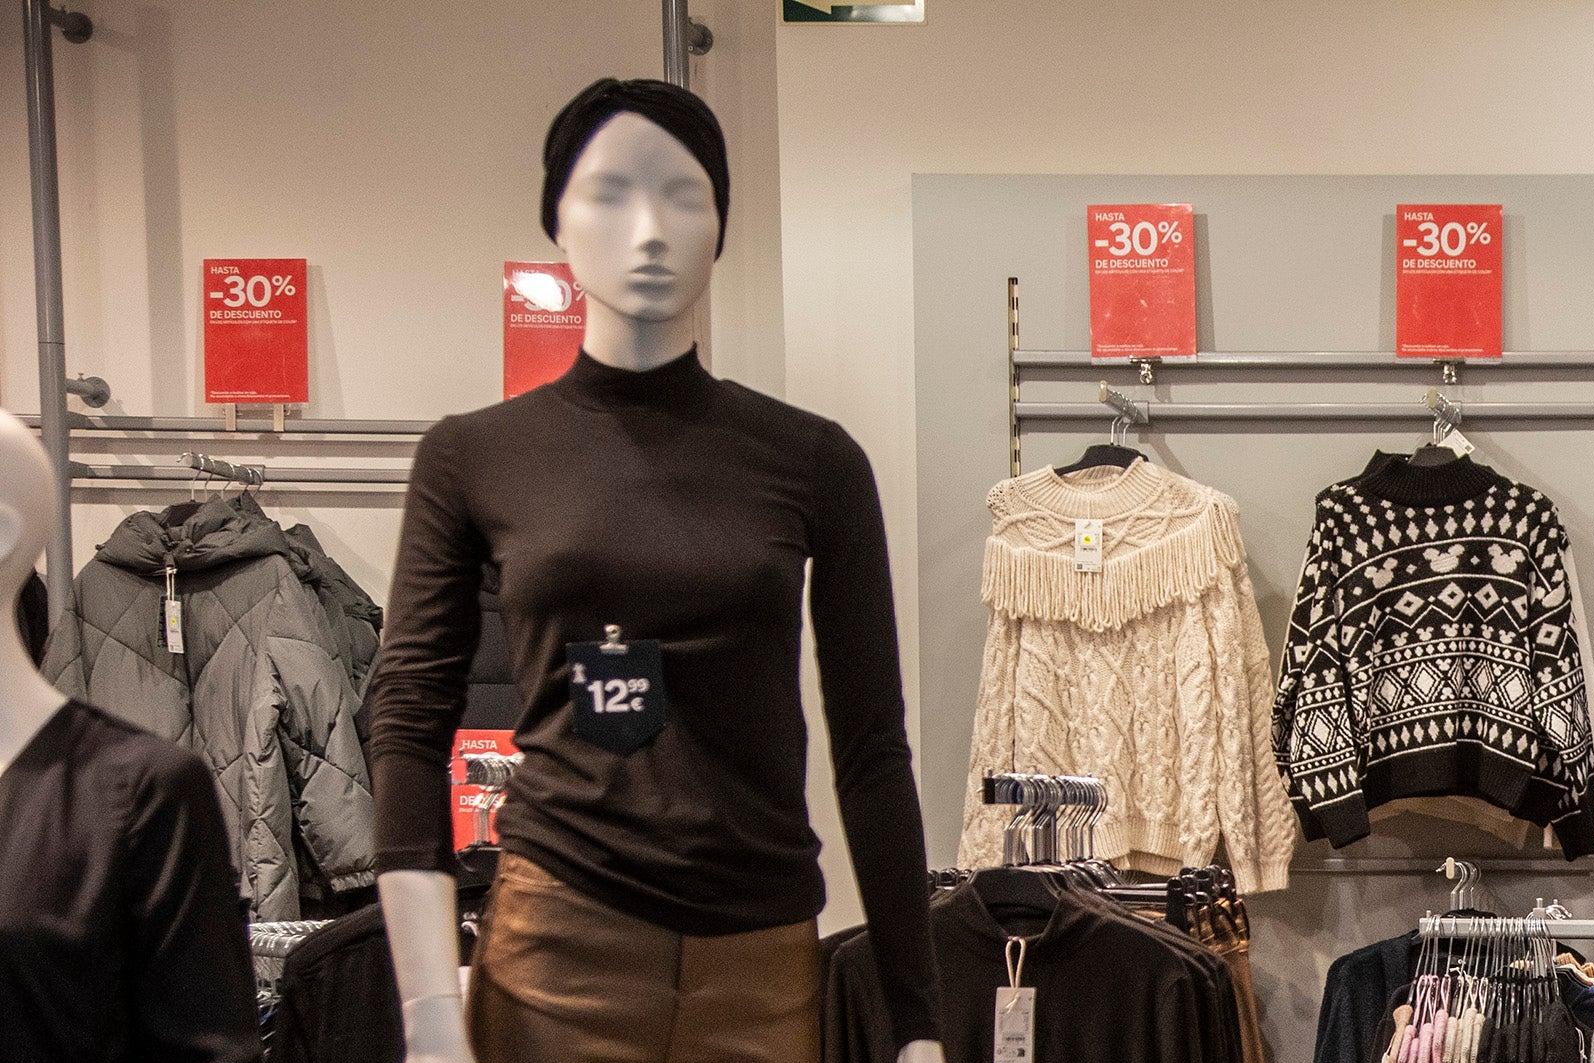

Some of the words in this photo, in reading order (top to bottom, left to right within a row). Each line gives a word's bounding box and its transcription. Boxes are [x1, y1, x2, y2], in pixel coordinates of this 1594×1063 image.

[1095, 212, 1125, 221] HASTA
[1404, 212, 1434, 220] HASTA
[1095, 221, 1182, 256] -30%
[1403, 222, 1491, 256] -30%
[1095, 259, 1108, 268] DE
[1110, 258, 1168, 268] DESCUENTO
[1403, 259, 1415, 268] DE
[1417, 259, 1476, 268] DESCUENTO
[211, 266, 240, 274] HASTA
[210, 275, 296, 307] -30%
[210, 310, 223, 318] DE
[224, 310, 281, 318] DESCUENTO
[511, 314, 523, 322] DE
[525, 314, 581, 324] DESCUENTO
[462, 740, 497, 749] HASTA
